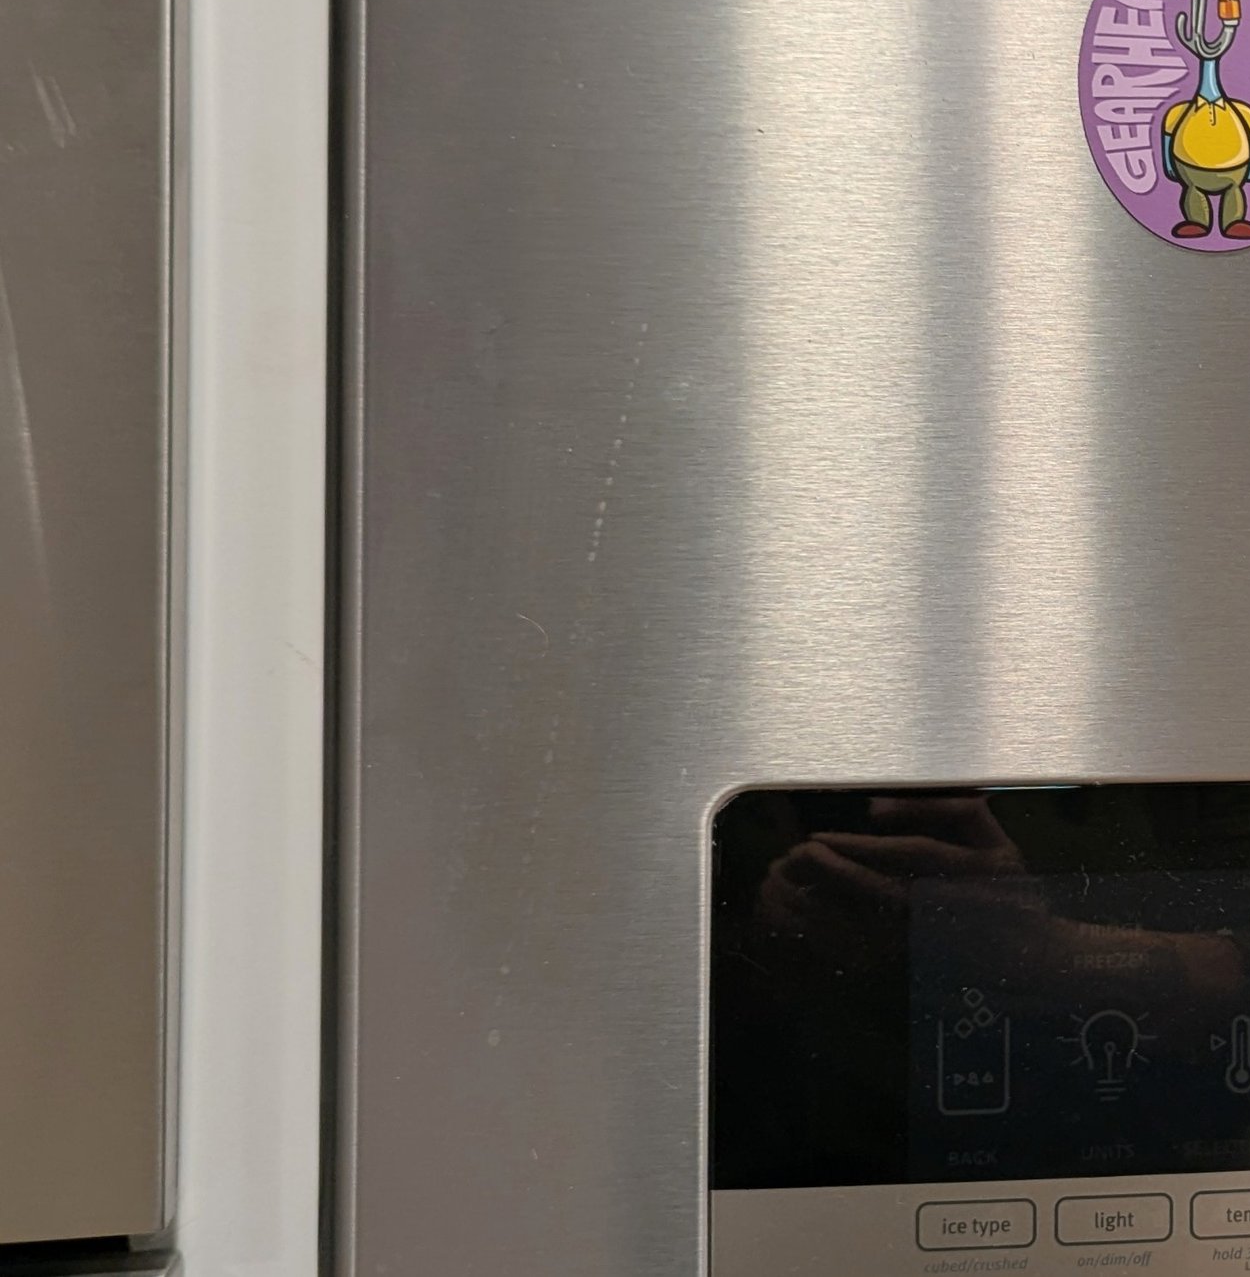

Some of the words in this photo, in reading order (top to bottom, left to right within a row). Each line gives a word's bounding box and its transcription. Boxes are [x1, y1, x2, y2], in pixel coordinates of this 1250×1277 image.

[942, 1218, 967, 1235] ice
[973, 1217, 1012, 1238] type
[1094, 1211, 1135, 1231] light
[1076, 1250, 1153, 1268] on/dim/off
[1212, 1247, 1242, 1261] hold
[924, 1256, 1028, 1275] cubed/crushed
